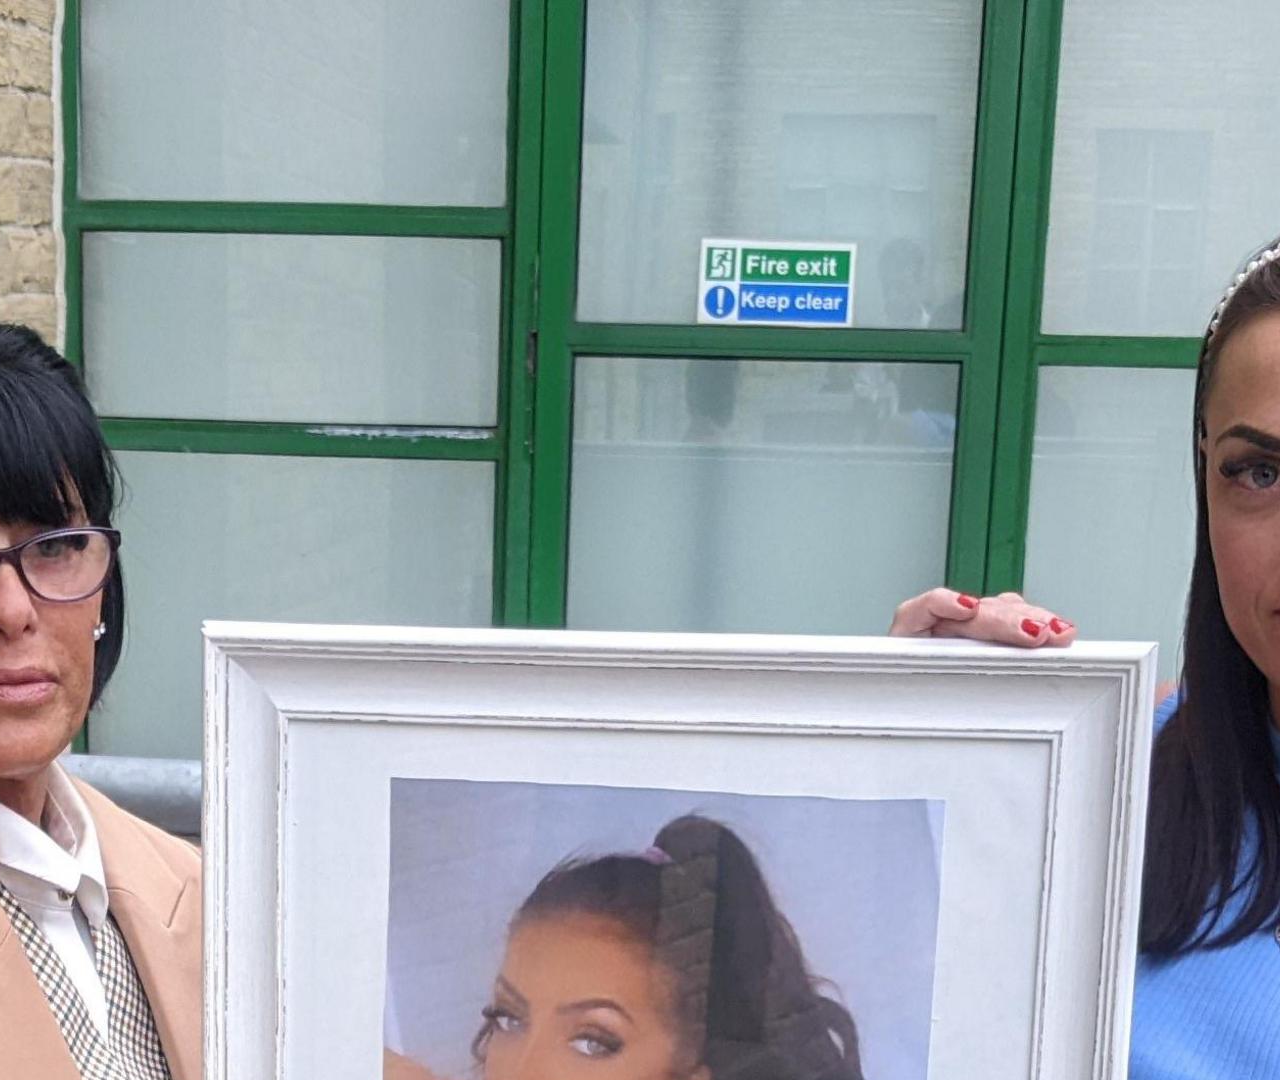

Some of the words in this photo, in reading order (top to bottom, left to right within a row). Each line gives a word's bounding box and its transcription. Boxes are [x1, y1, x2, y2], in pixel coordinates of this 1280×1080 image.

[746, 254, 789, 275] Fire
[795, 256, 838, 277] exit
[741, 290, 791, 312] Keep
[794, 292, 842, 311] clear
